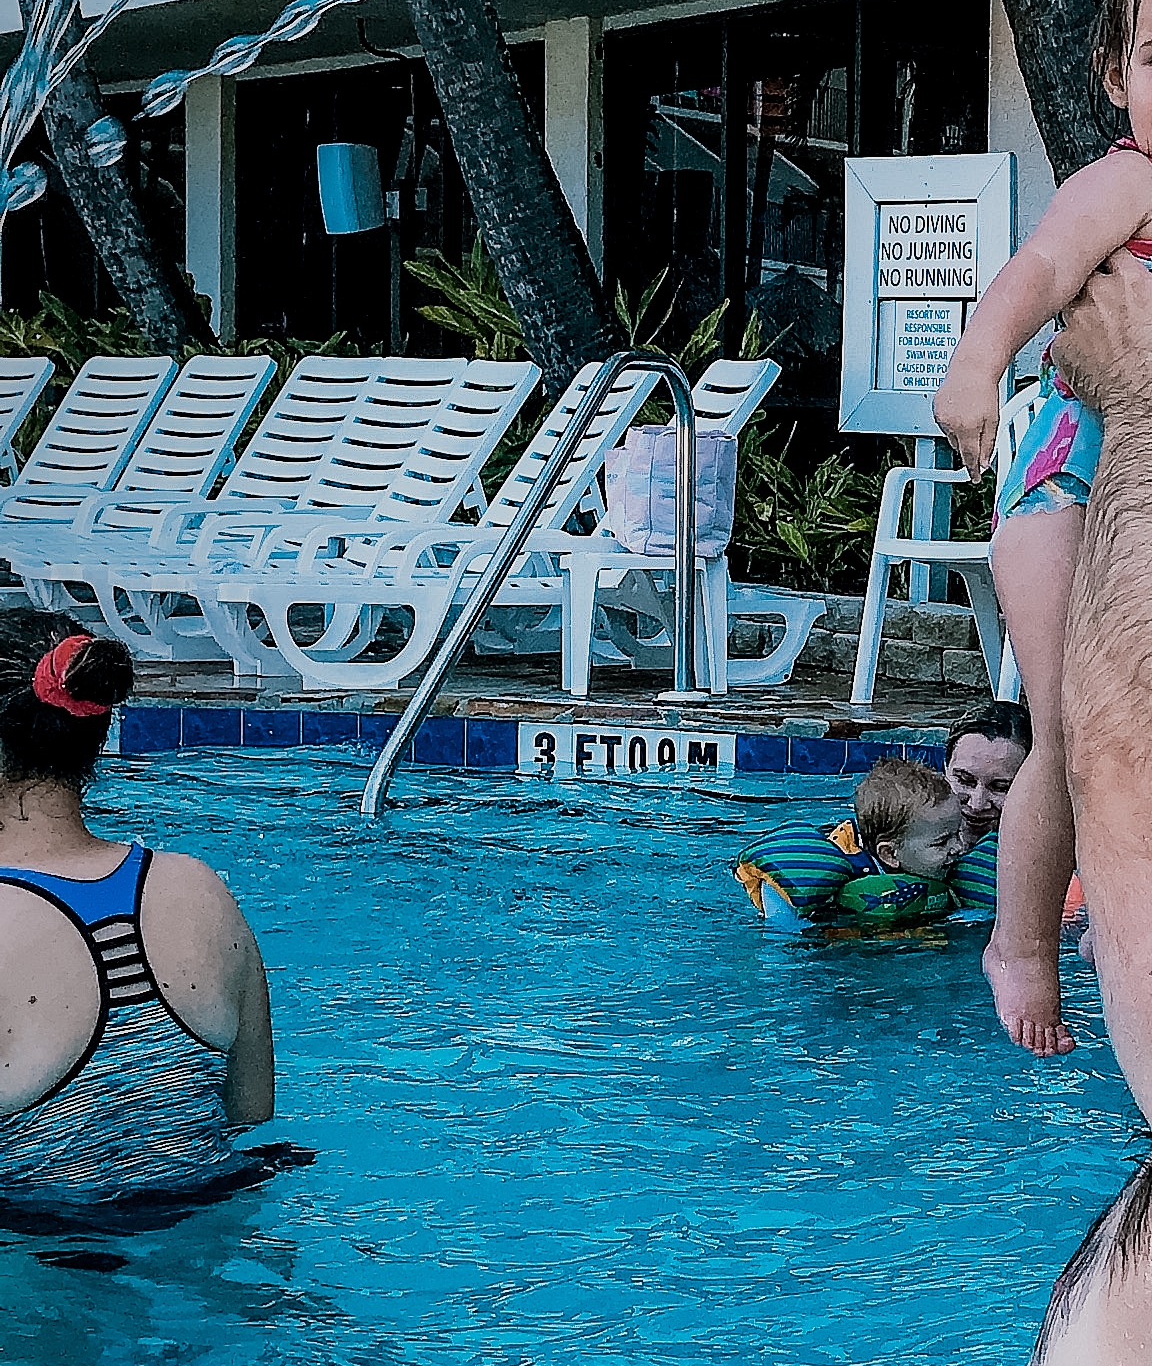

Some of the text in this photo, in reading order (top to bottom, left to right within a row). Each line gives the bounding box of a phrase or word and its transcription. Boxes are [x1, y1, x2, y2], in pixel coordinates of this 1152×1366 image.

[889, 214, 966, 234] NO DIVING
[881, 240, 973, 261] NO JUMPING
[879, 267, 973, 287] NO RUNNING
[906, 309, 951, 319] RESORT NOT
[904, 323, 952, 333] RESPONSIBLE
[898, 336, 957, 347] FOR DAMAGE TO
[927, 350, 948, 360] WEAR
[896, 363, 926, 373] CAUSED
[926, 363, 936, 373] BY
[903, 377, 914, 387] OR
[914, 377, 930, 387] HOT
[534, 732, 556, 777] 3
